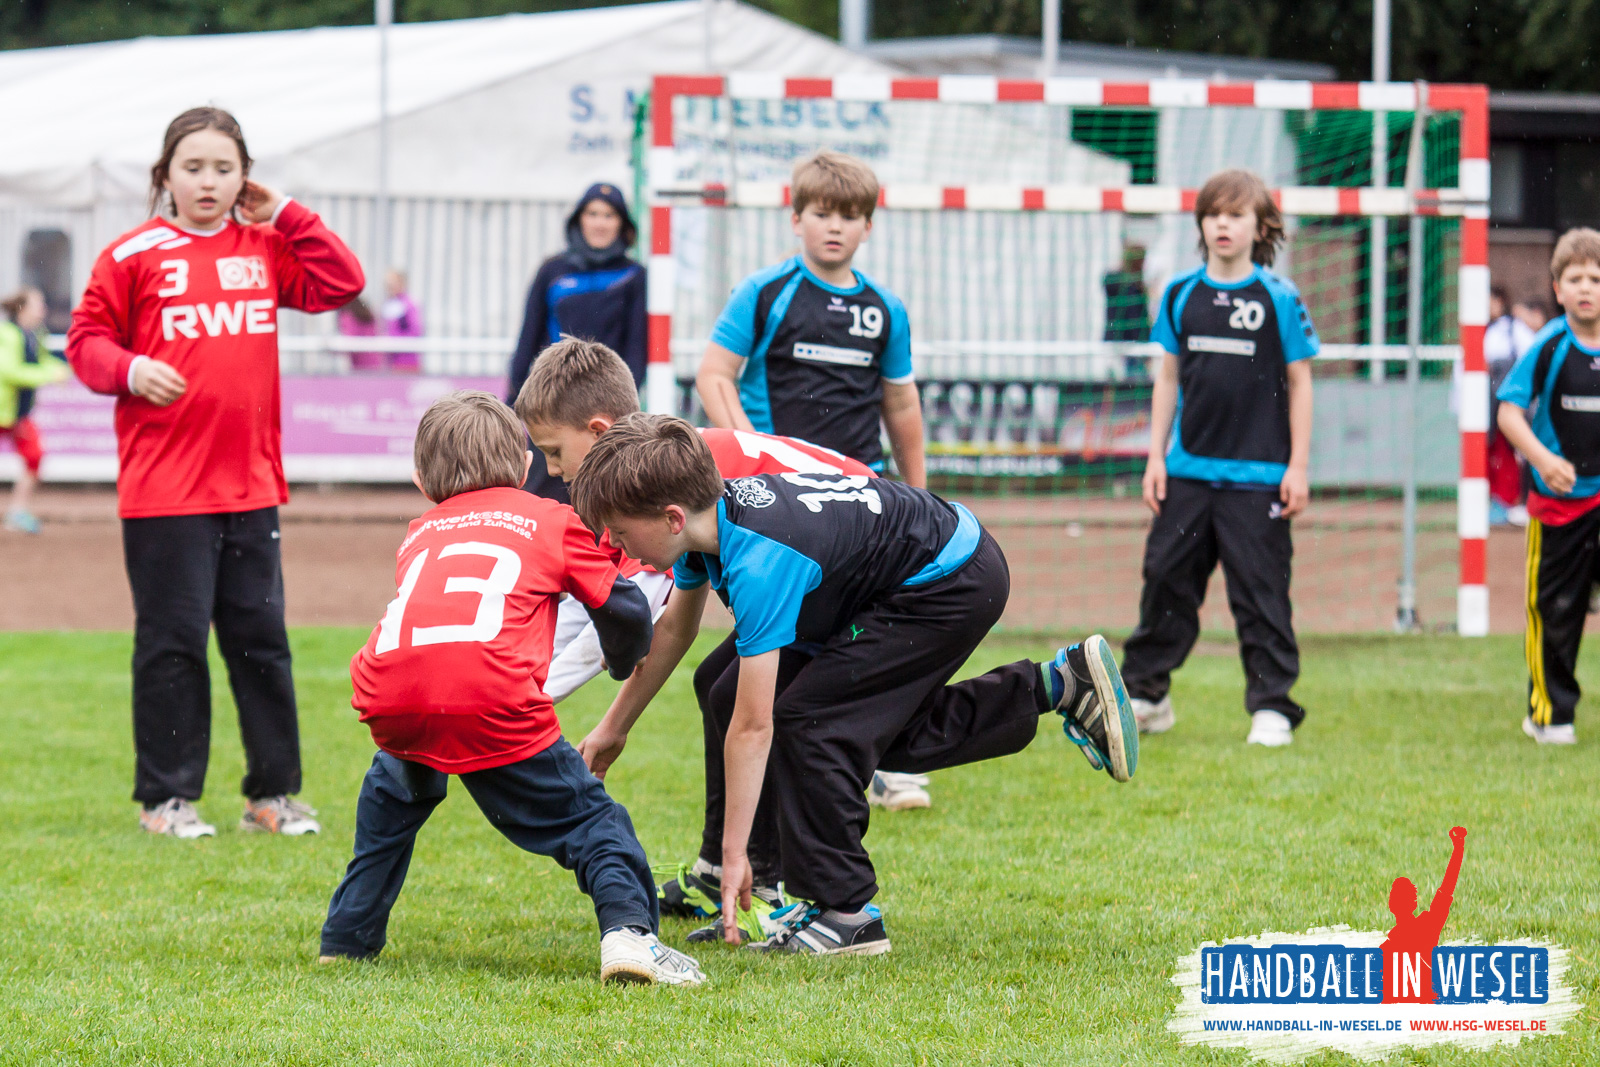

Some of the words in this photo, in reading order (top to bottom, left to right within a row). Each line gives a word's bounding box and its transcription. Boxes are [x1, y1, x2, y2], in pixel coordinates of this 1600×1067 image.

[158, 259, 189, 298] 3
[161, 299, 276, 341] RWE
[848, 304, 884, 339] 19
[1229, 297, 1266, 331] 20
[436, 523, 455, 532] Wir
[456, 520, 481, 528] sind
[483, 519, 533, 540] Zuhause.
[375, 541, 522, 655] 13
